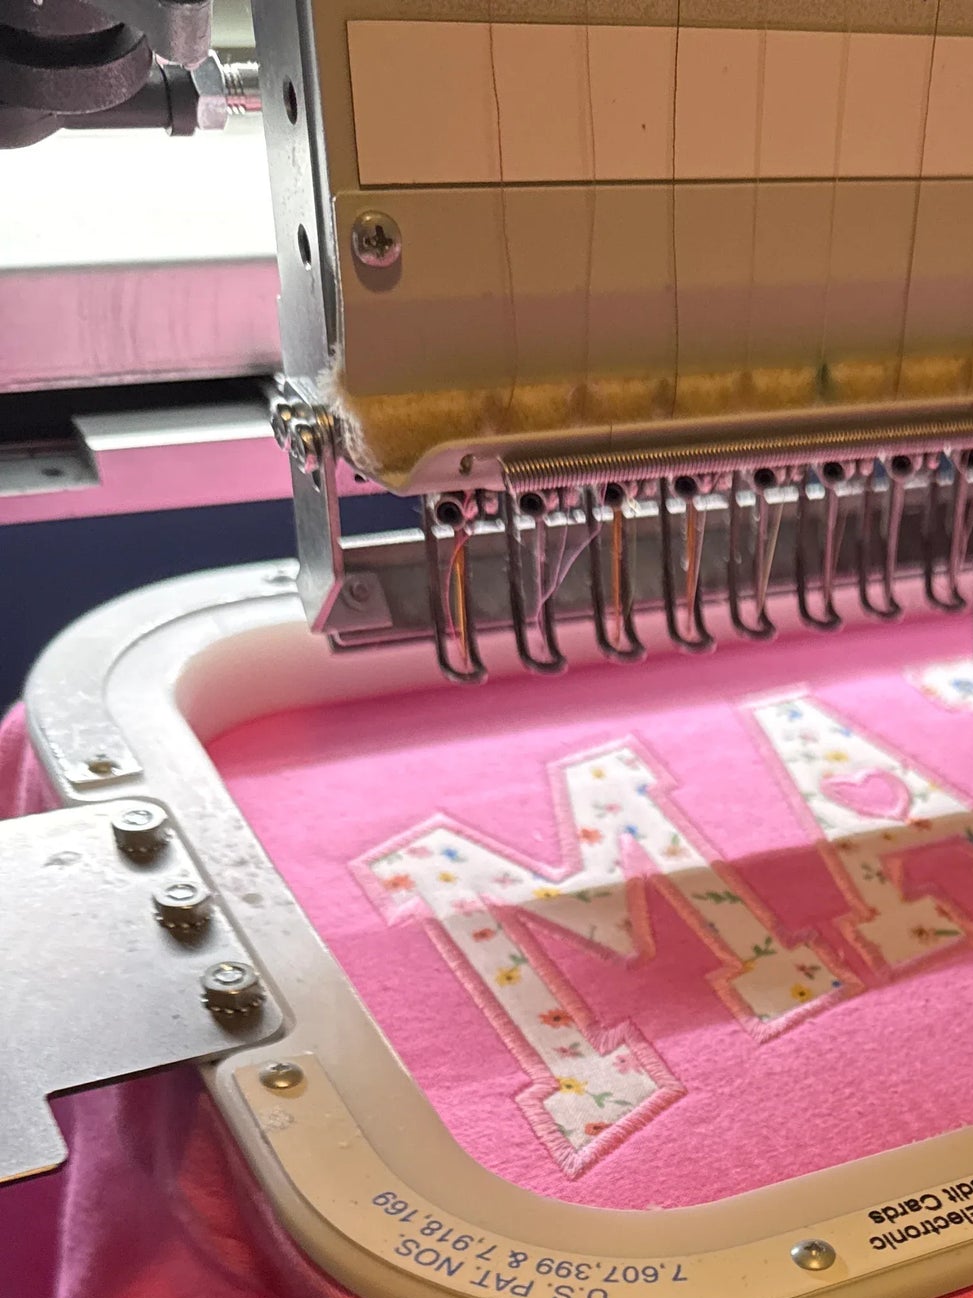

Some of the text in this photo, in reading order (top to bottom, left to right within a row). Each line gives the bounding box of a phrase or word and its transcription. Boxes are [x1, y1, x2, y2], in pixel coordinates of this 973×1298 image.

[867, 1193, 943, 1225] Cards
[372, 1190, 689, 1284] 7,607,399 & 7,918,169
[394, 1233, 465, 1277] NOS.
[470, 1266, 535, 1298] PAT.
